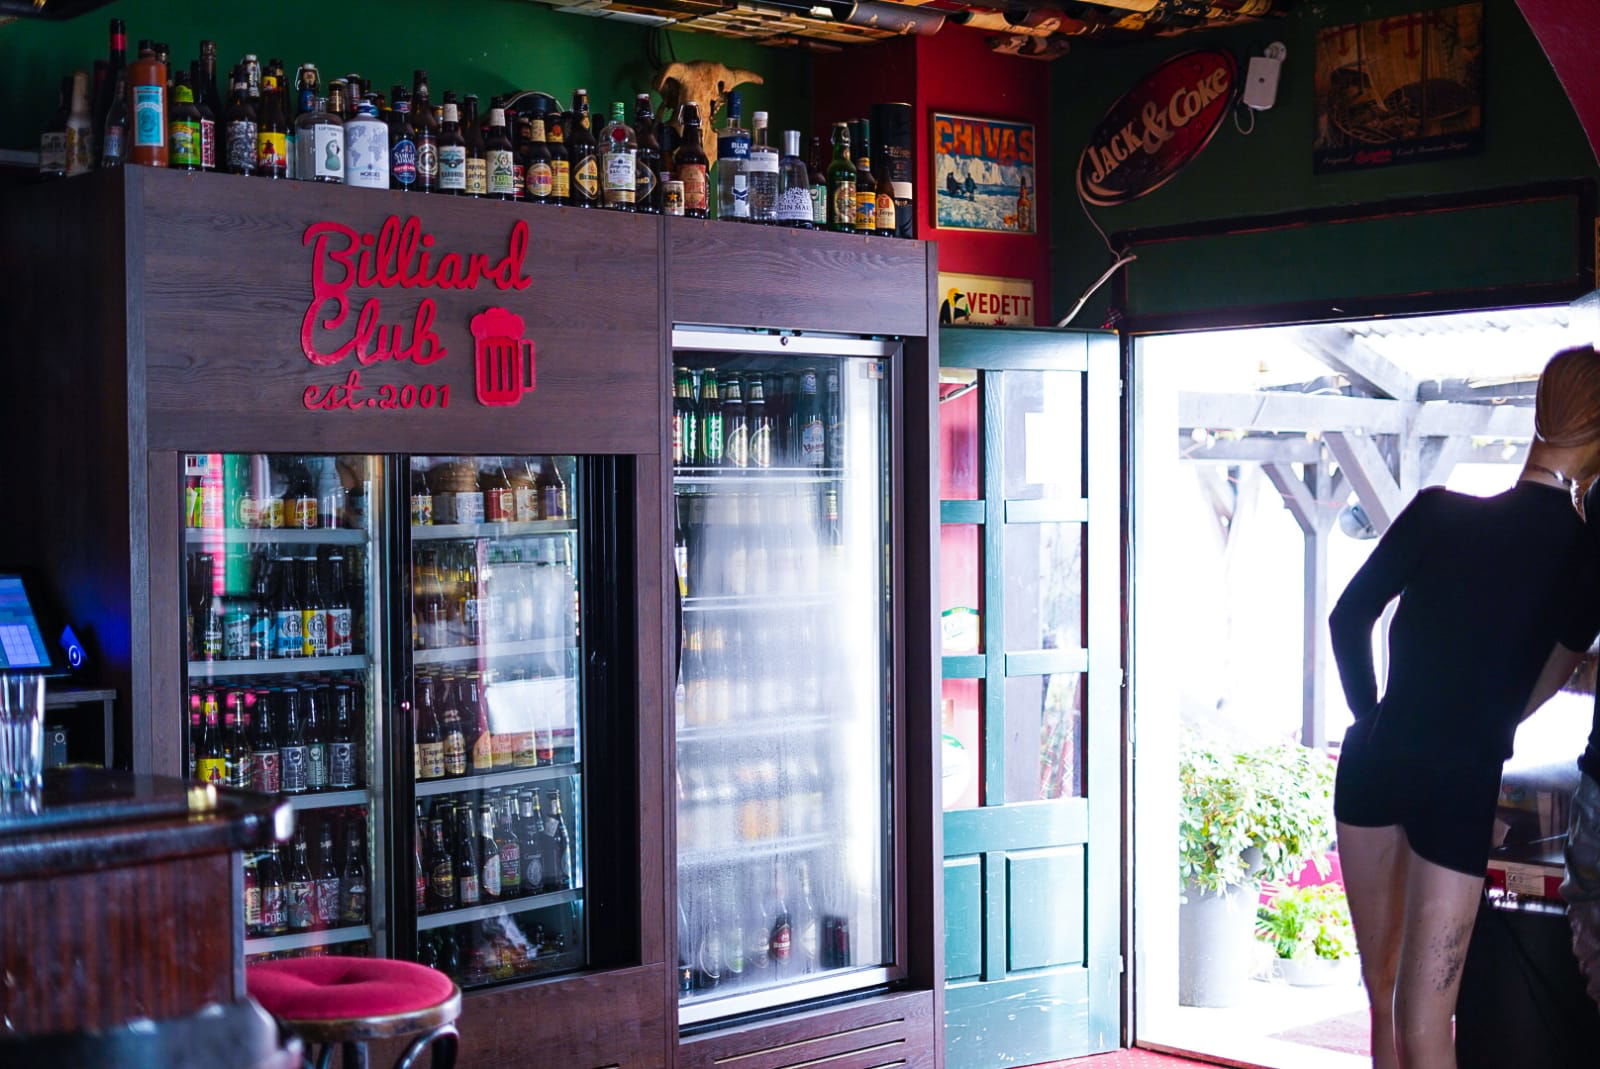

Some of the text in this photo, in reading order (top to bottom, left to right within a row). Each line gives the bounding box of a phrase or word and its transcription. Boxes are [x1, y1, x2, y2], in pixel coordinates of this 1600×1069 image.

[731, 141, 749, 149] BLUE
[935, 119, 1034, 164] CHIVAS
[302, 214, 533, 291] Billiard
[966, 291, 1032, 317] VEDETT
[300, 296, 449, 367] Club
